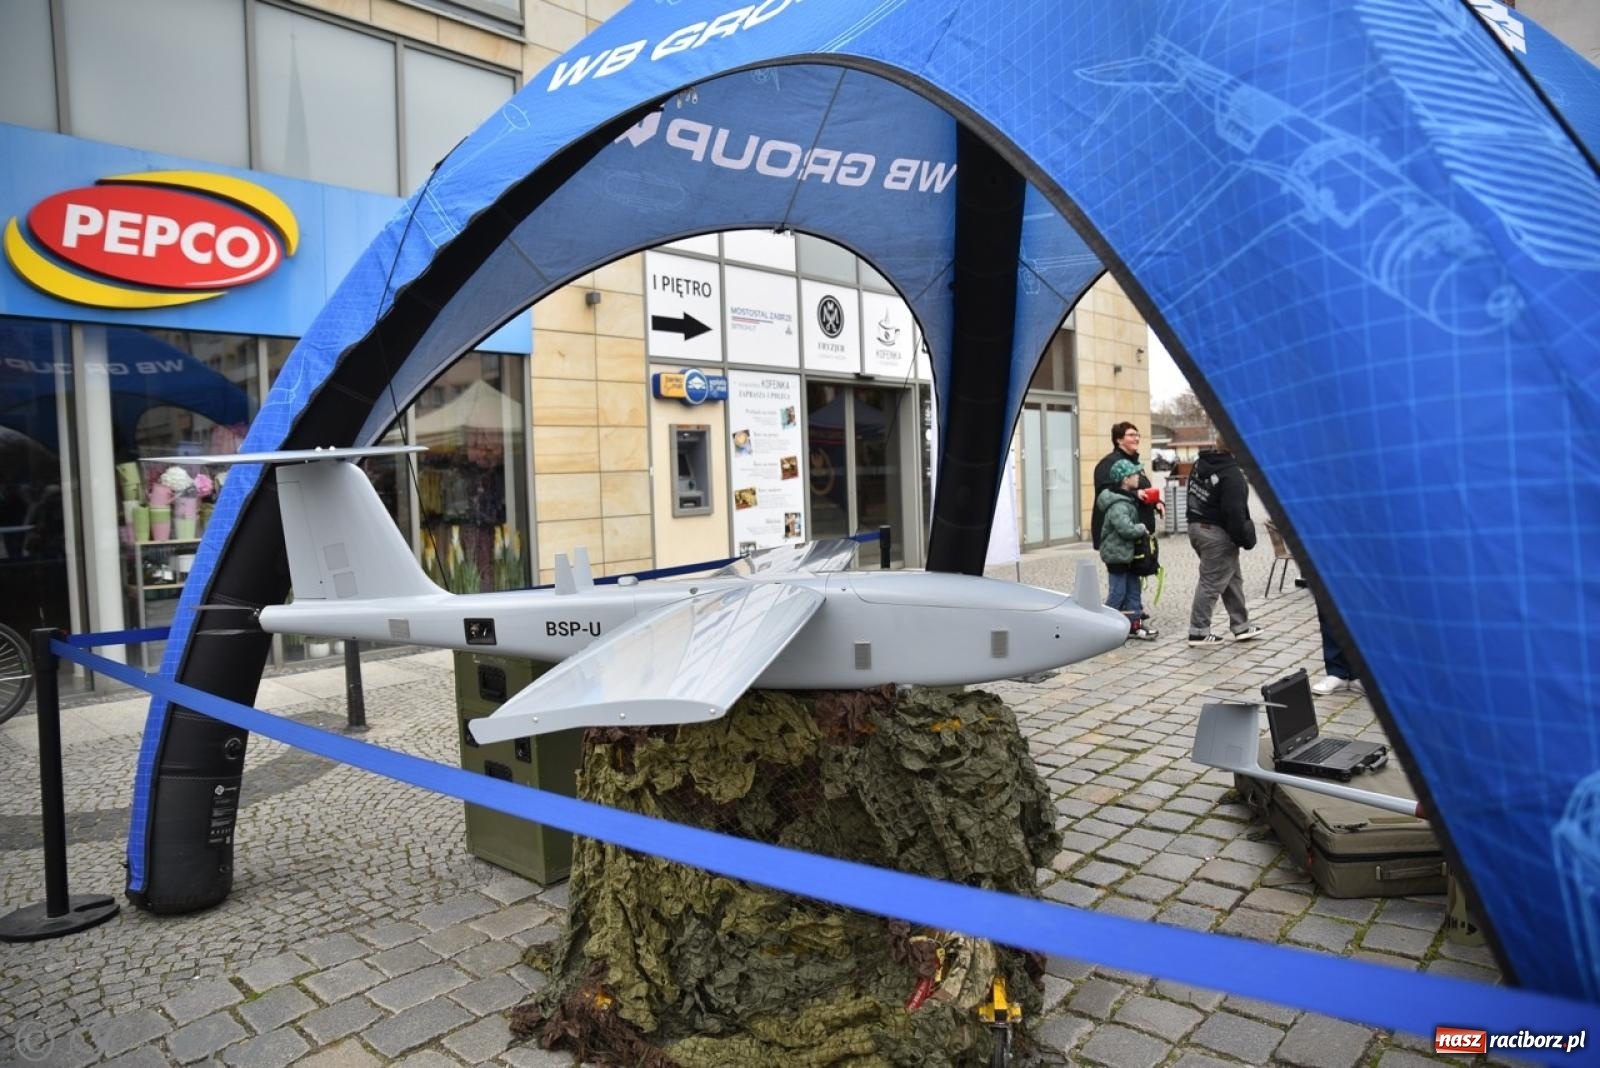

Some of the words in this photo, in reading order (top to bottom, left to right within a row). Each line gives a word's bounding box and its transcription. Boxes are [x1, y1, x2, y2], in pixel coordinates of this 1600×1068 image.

[547, 40, 648, 92] WB
[650, 0, 801, 61] GRO
[62, 203, 261, 268] PEPCO
[662, 275, 712, 298] PIĘTRO
[730, 307, 768, 319] MOSTOSTAL
[546, 621, 601, 637] BSP-U
